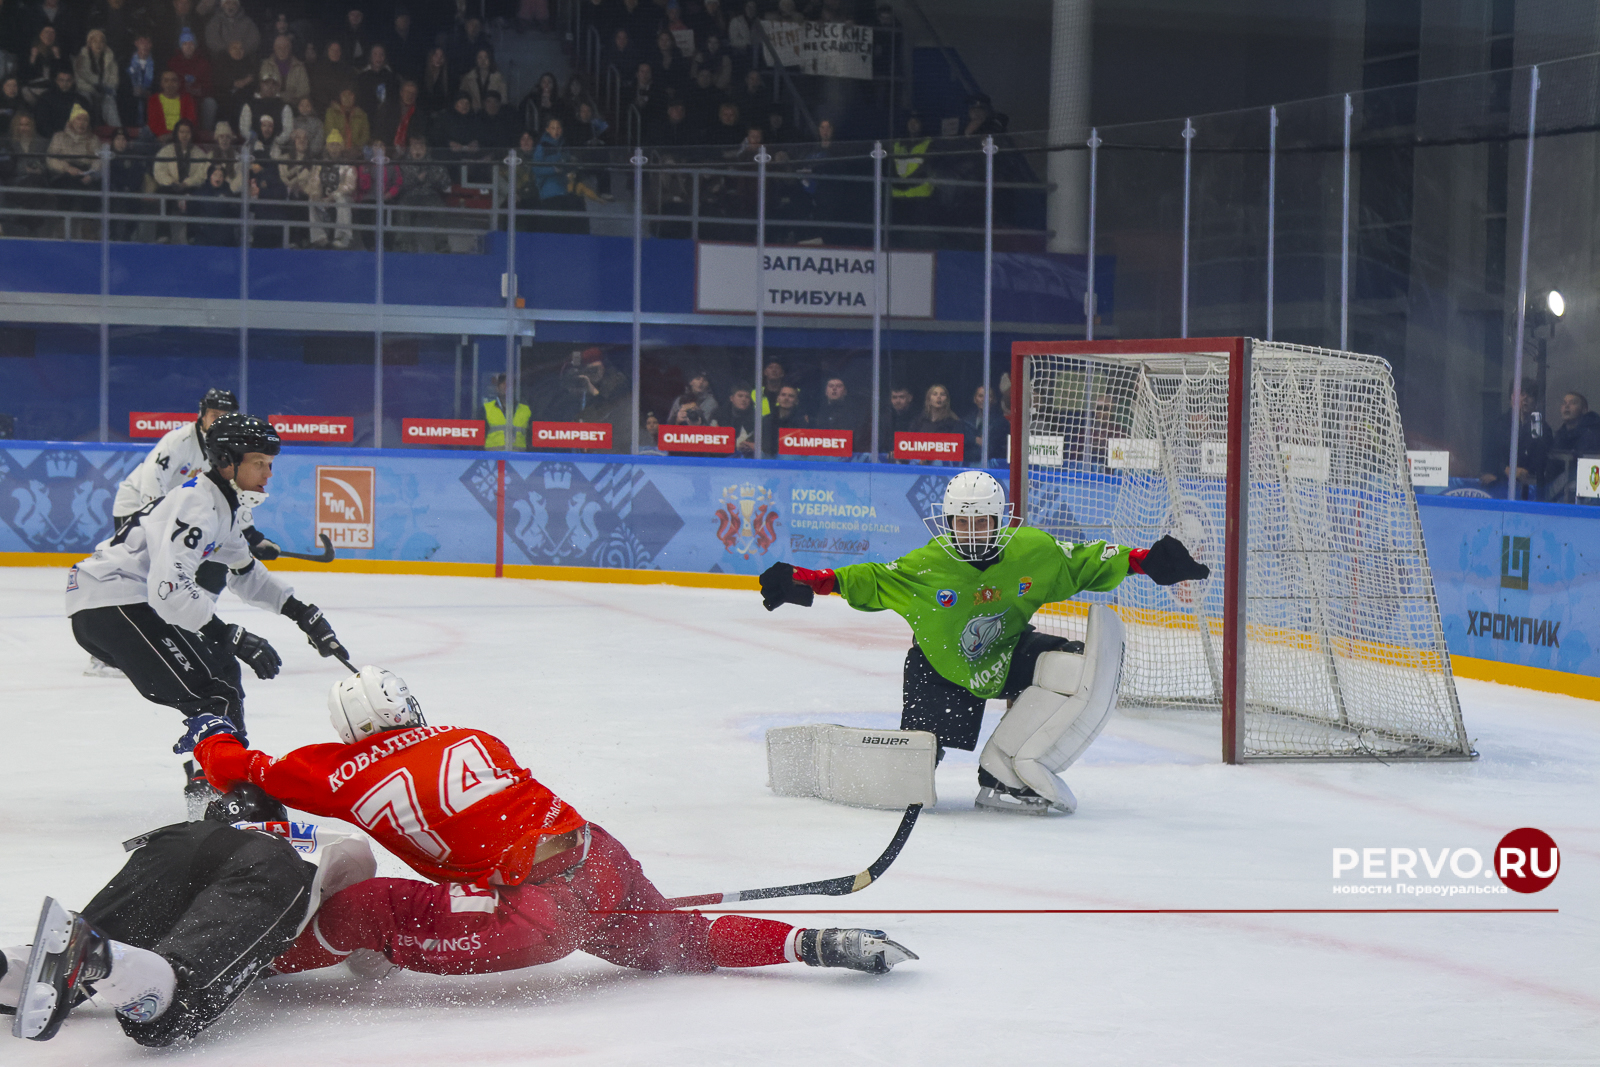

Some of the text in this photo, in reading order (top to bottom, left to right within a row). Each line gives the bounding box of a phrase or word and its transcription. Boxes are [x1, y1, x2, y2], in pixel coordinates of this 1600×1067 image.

[804, 22, 870, 42] РУССКИЕ
[763, 255, 875, 275] ЗАПАДНАЯ
[768, 289, 867, 307] ТРИБУНА
[275, 423, 347, 435] OLIMPBET
[408, 426, 479, 438] OLIMPBET
[538, 429, 606, 441] OLIMPBET
[663, 433, 730, 445] OLIMPBET
[784, 436, 847, 449] OLIMPBET
[899, 440, 959, 453] OLIMPBET
[792, 488, 835, 502] КУБОК
[322, 492, 356, 520] ТМК
[792, 503, 877, 518] ГУБЕРНАТОРА
[171, 517, 203, 549] 78
[791, 519, 860, 532] СВЕРДЛОВСКОЙ
[861, 523, 900, 533] ОБЛАСТИ
[320, 527, 369, 543] ПНТЗ
[790, 534, 869, 552] Русский Хоккей
[1466, 610, 1561, 648] ХРОМПИК
[162, 637, 194, 672] STEX
[350, 734, 520, 863] 74
[228, 801, 240, 815] 6
